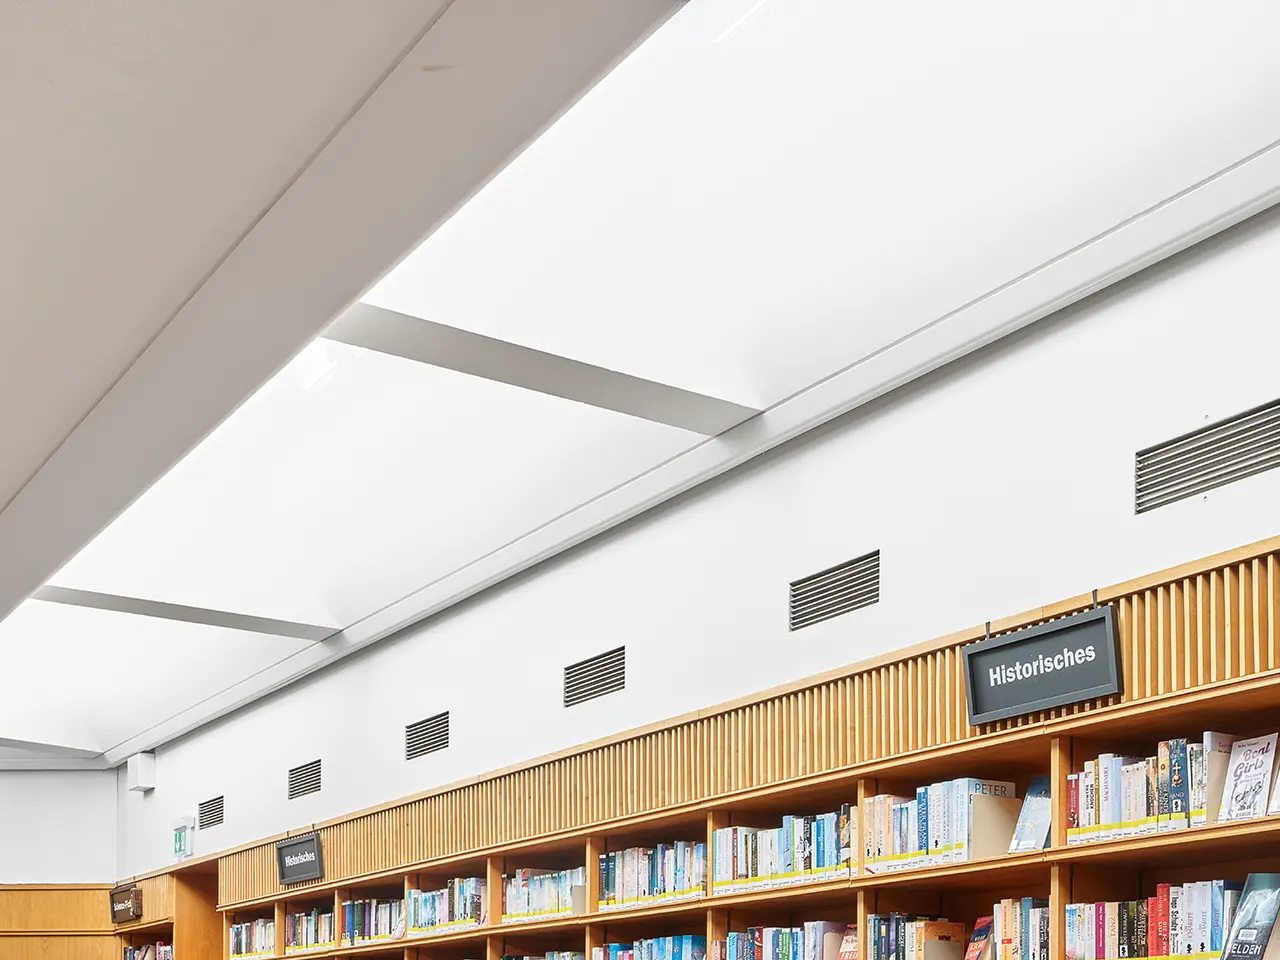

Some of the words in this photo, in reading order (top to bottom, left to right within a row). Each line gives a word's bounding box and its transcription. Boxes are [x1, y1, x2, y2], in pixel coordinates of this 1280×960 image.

[988, 645, 1096, 687] Historisches
[1243, 741, 1272, 762] Boat
[1233, 758, 1264, 782] Girls
[974, 782, 1007, 797] PETER
[284, 850, 316, 868] Historisches
[1170, 896, 1179, 909] Ingo
[1170, 910, 1179, 935] Schulze
